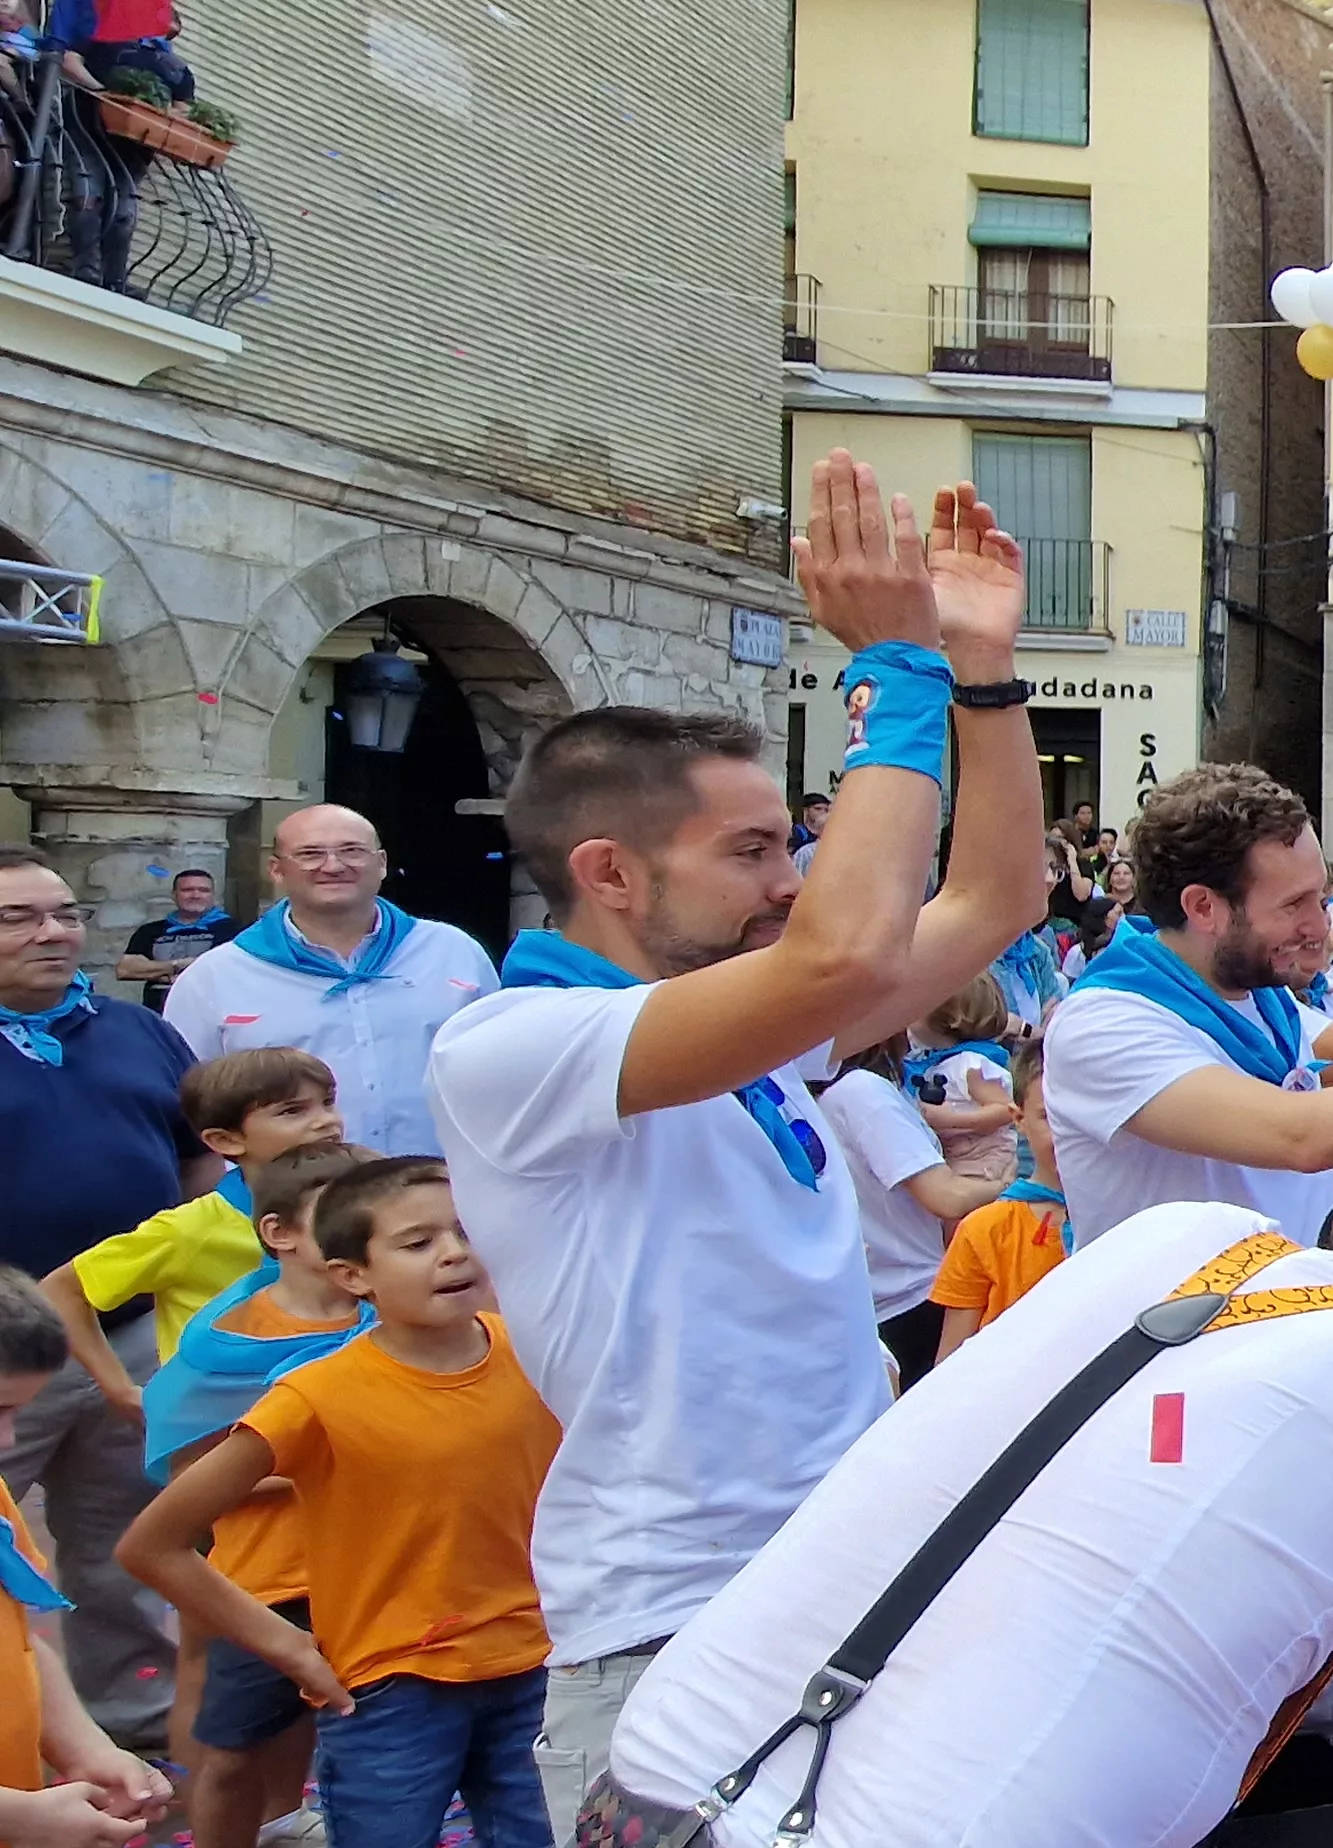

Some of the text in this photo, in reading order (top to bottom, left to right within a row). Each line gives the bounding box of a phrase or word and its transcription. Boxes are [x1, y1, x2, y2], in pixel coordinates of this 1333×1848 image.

[751, 620, 781, 638] PLAZA
[1147, 614, 1181, 628] CALLE
[1132, 628, 1179, 643] MAYOR
[737, 637, 782, 660] MAYOR
[1031, 676, 1153, 700] dadana
